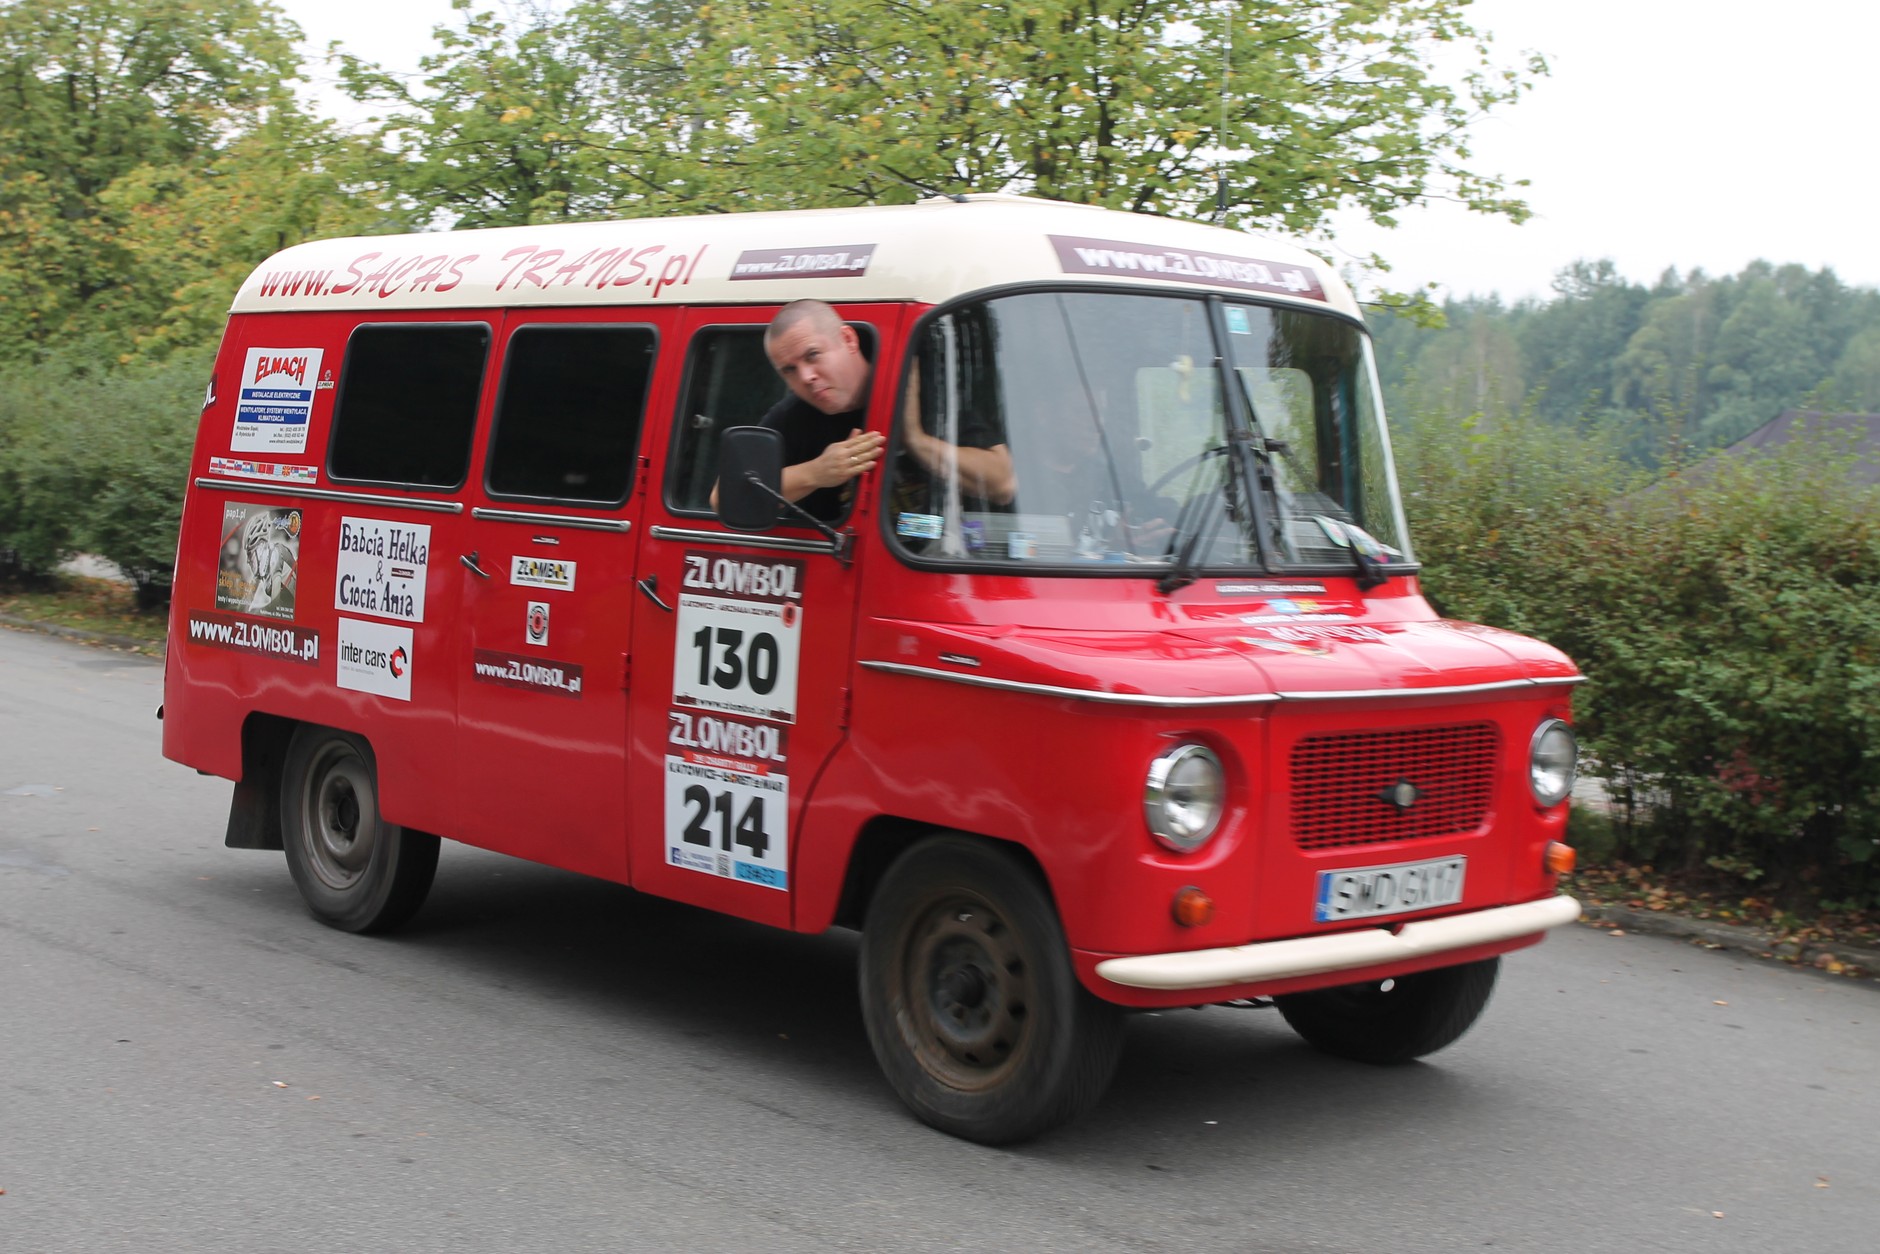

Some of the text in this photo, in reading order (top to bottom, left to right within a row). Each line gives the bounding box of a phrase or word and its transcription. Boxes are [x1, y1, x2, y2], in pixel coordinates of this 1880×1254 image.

[496, 244, 710, 298] TRANS.pl
[254, 356, 308, 387] ELMACH
[257, 414, 285, 422] KLIMATYZACJA
[225, 508, 247, 521] pap1.pl
[340, 523, 427, 566] Babcia Helka
[375, 560, 384, 584] &
[339, 573, 415, 617] Ciocia Ania
[341, 640, 387, 669] inter cars
[693, 625, 779, 695] 130
[682, 783, 770, 859] 214
